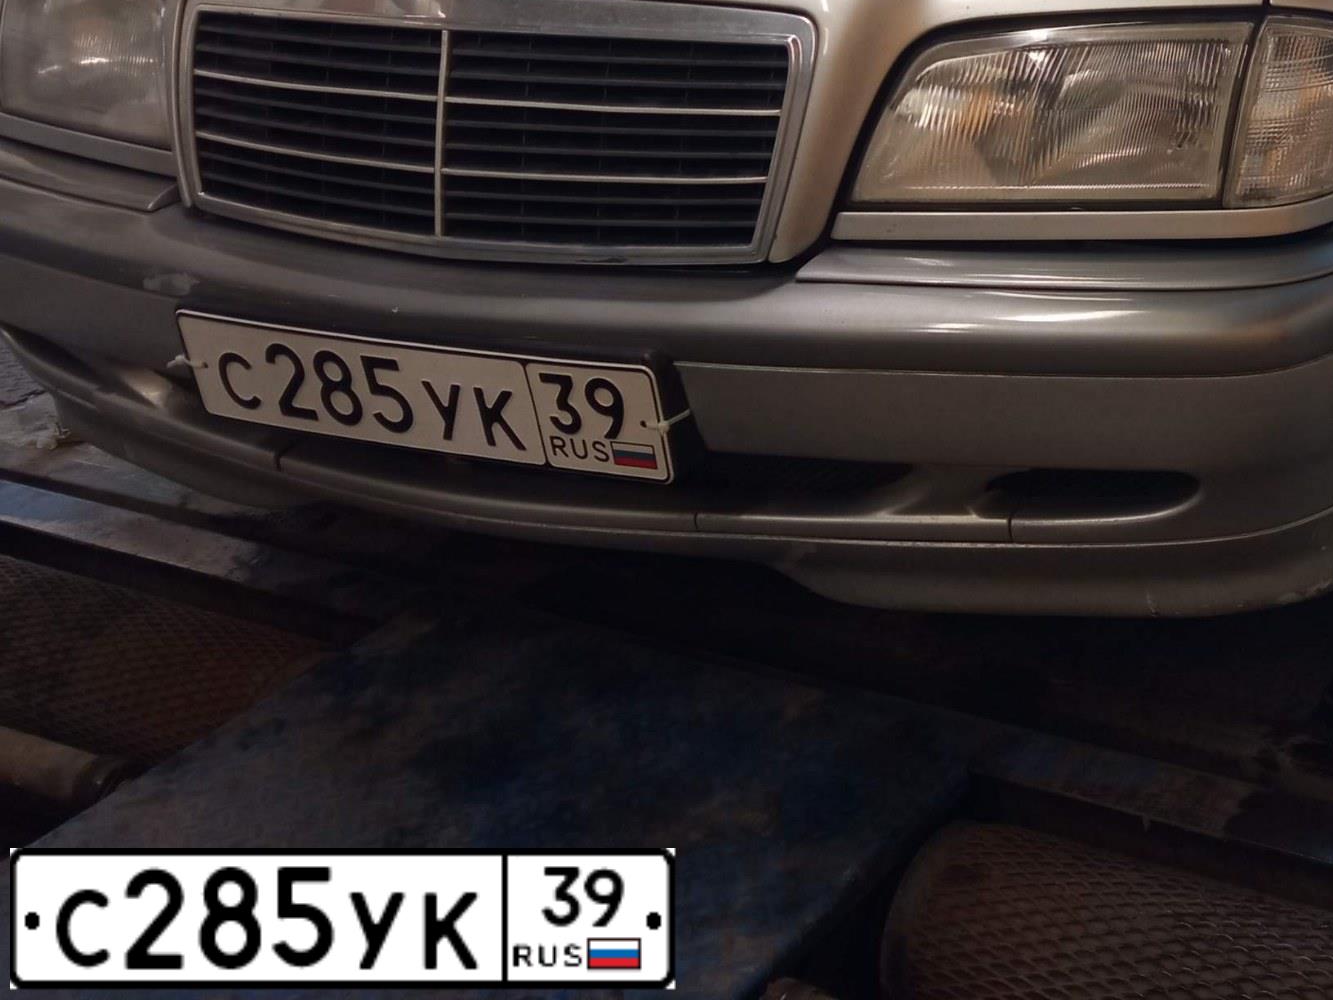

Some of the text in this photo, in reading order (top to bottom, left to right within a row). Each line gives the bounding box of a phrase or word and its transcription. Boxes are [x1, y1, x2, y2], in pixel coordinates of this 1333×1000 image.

[218, 343, 624, 452] С285УК 39
[551, 435, 609, 462] RUS
